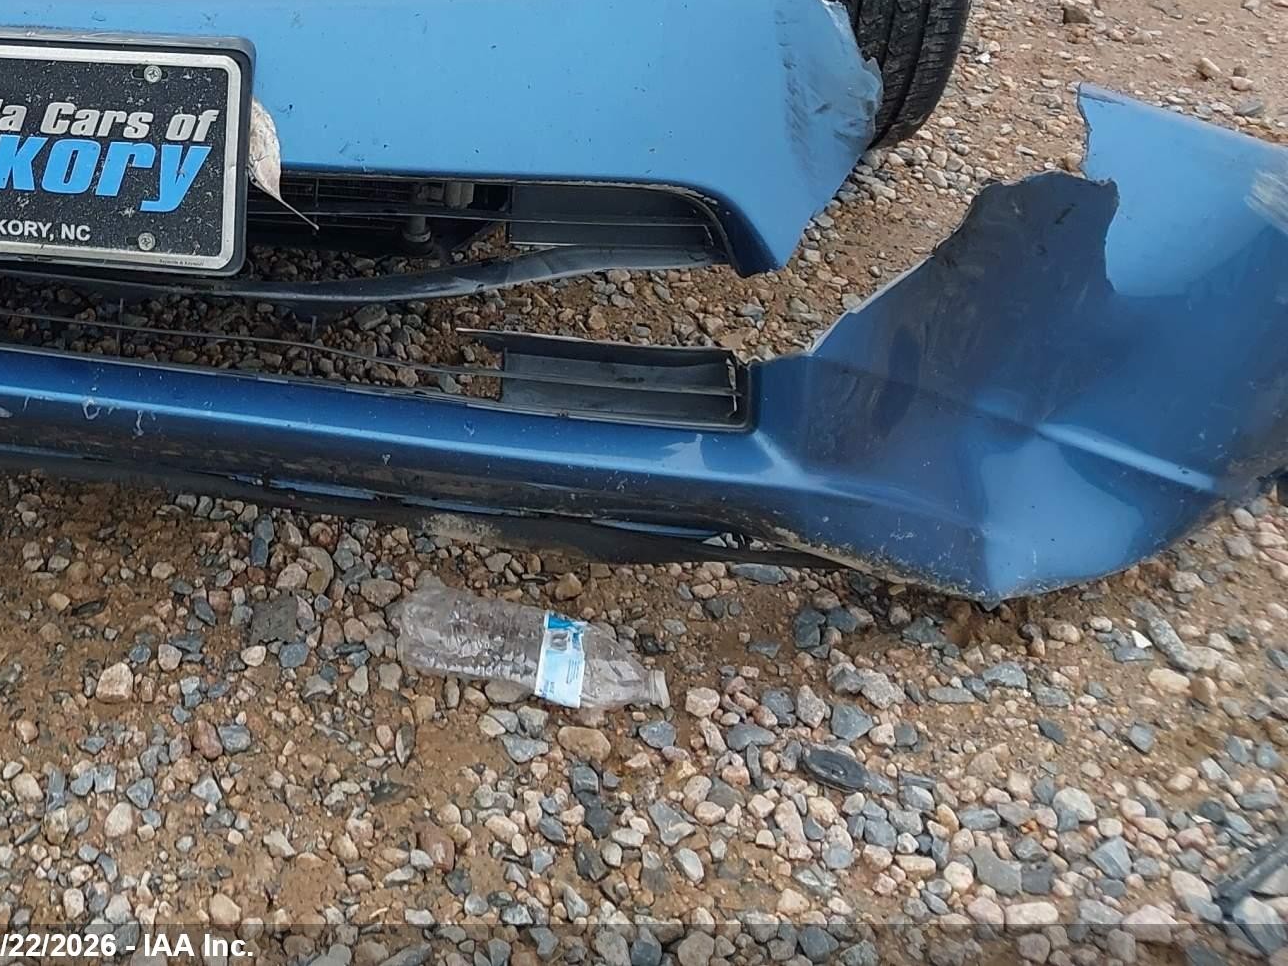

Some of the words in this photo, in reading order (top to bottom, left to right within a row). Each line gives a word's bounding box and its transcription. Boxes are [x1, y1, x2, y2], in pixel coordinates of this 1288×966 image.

[40, 102, 154, 139] Cars
[165, 110, 220, 142] of
[61, 223, 91, 241] NC
